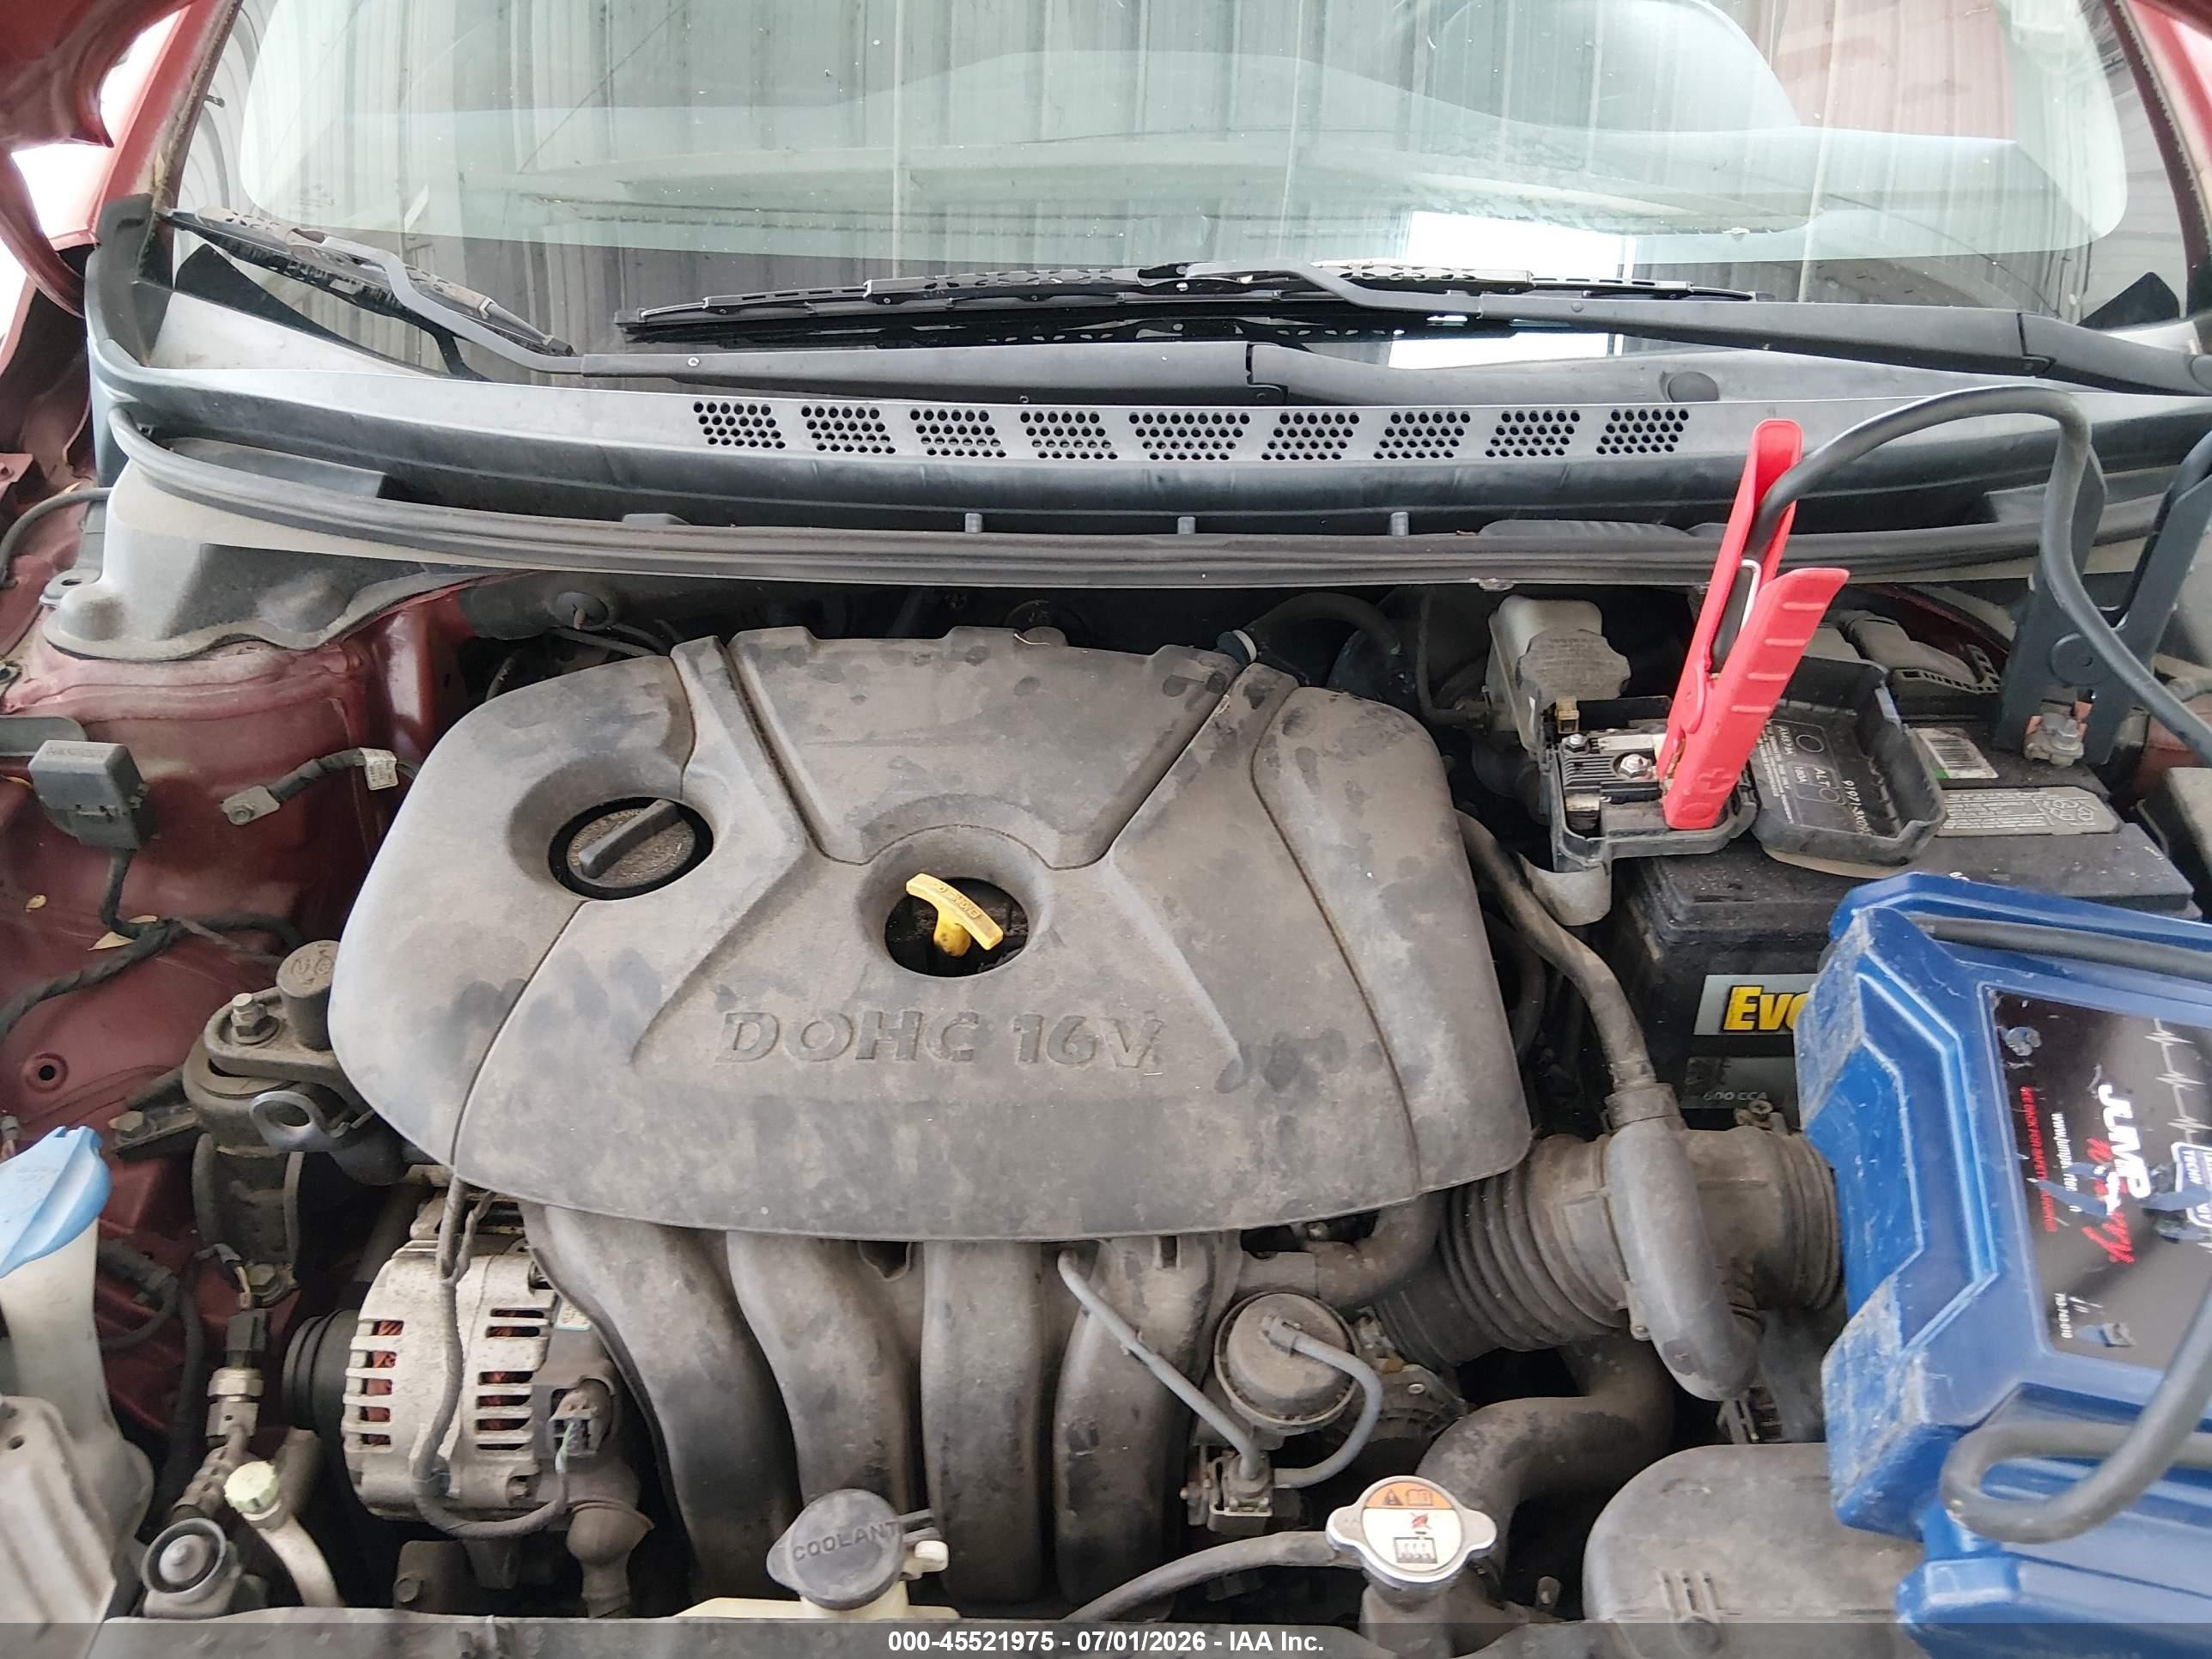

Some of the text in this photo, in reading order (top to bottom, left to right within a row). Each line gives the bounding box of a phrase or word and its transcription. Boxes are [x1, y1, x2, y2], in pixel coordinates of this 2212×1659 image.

[1814, 768, 1830, 787] ALT
[714, 1010, 1165, 1069] DOHC 16V
[2098, 1084, 2151, 1198] JUMP
[792, 1520, 900, 1561] COOLANT
